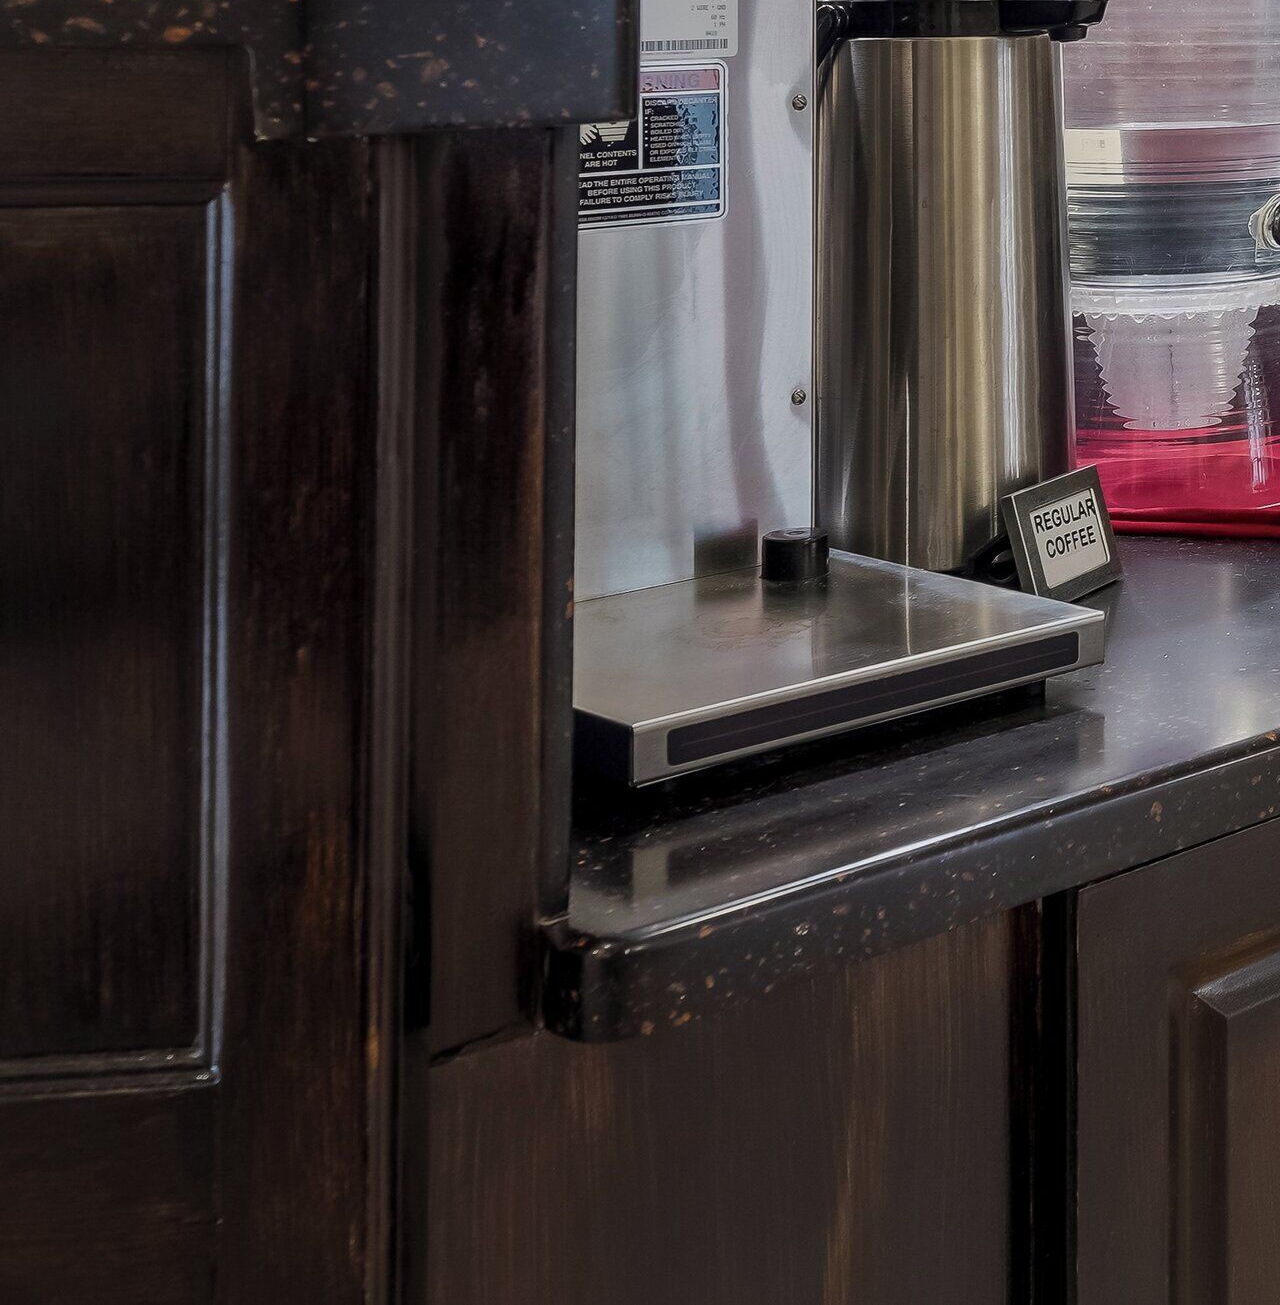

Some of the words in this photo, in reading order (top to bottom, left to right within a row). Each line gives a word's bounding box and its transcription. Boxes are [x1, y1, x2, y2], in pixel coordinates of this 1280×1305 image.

[580, 152, 596, 160] NEL
[596, 150, 637, 159] CONTENTS
[602, 159, 618, 167] HOT
[578, 181, 593, 189] EAD
[610, 177, 638, 187] ENTIRE
[638, 174, 680, 184] OPERATING
[587, 188, 619, 197] BEFORE
[620, 186, 643, 194] USING
[644, 184, 661, 192] THIS
[661, 181, 696, 191] PRODUCT
[580, 197, 612, 206] FAILURE
[623, 193, 654, 203] COMPLY
[655, 192, 677, 200] RISKS
[1033, 498, 1097, 534] REGULAR
[1046, 525, 1097, 558] COFFEE
